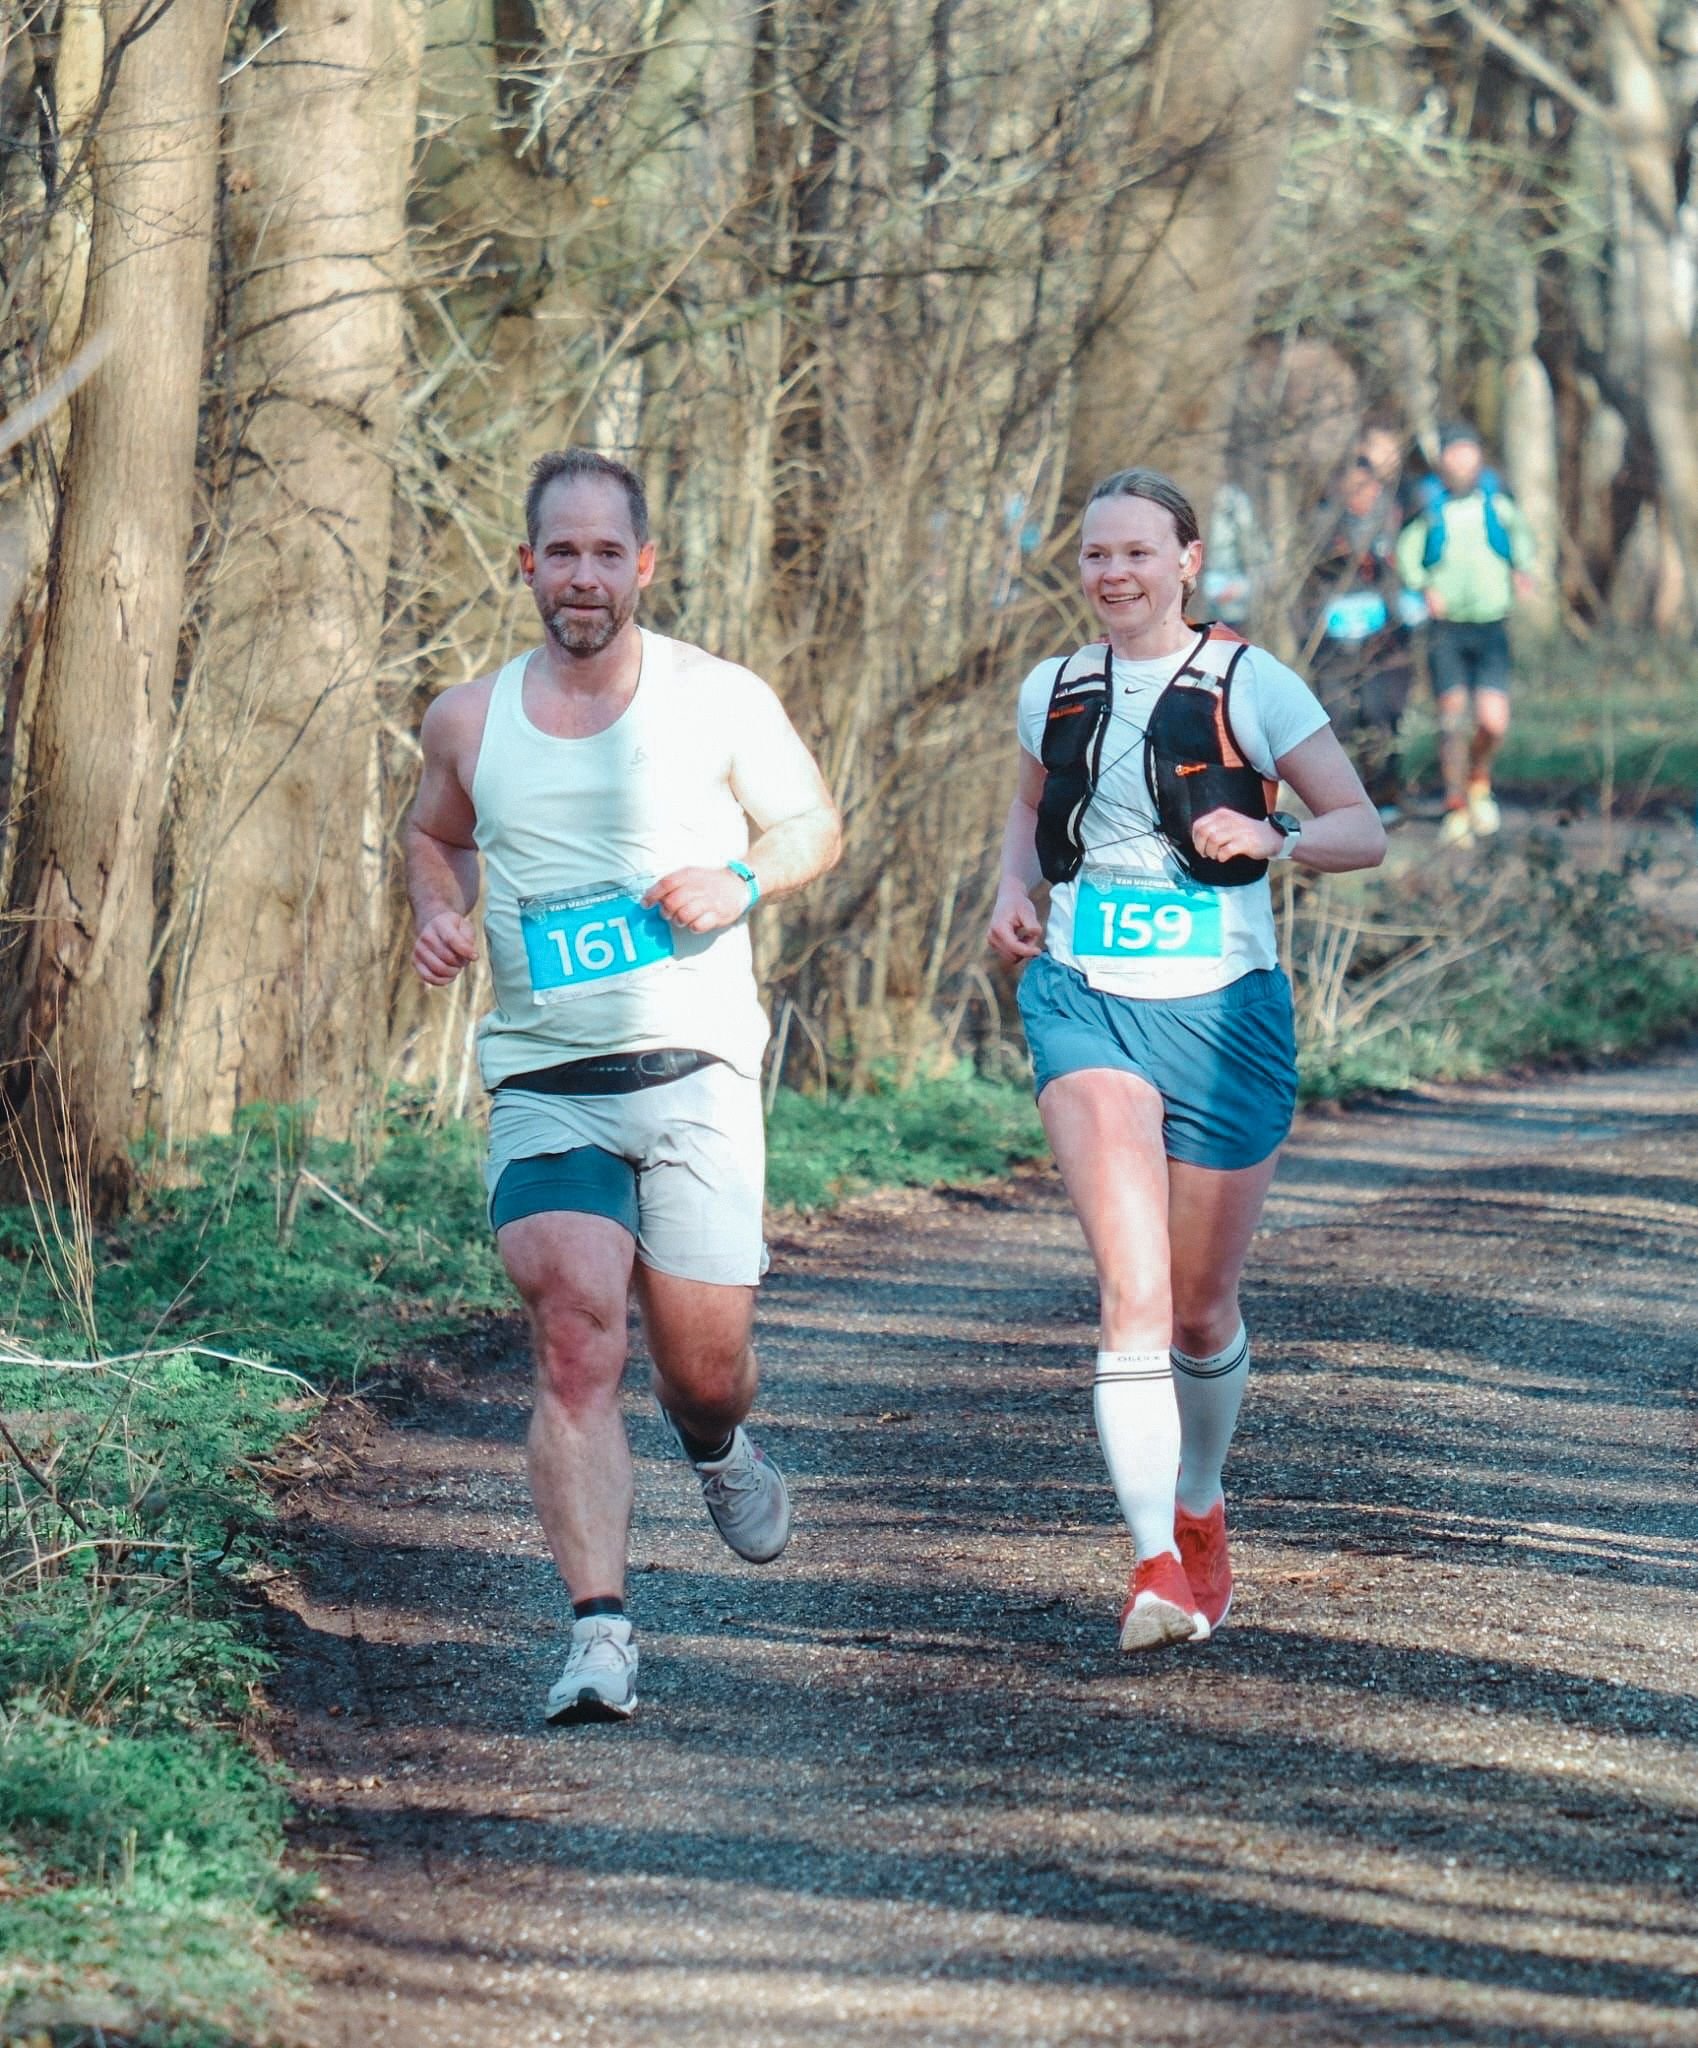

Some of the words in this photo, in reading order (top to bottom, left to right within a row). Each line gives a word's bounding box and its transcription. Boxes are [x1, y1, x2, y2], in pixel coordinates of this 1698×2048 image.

[1116, 878, 1132, 886] VAN
[549, 904, 566, 912] VAN
[1099, 901, 1192, 950] 159
[547, 916, 637, 976] 161
